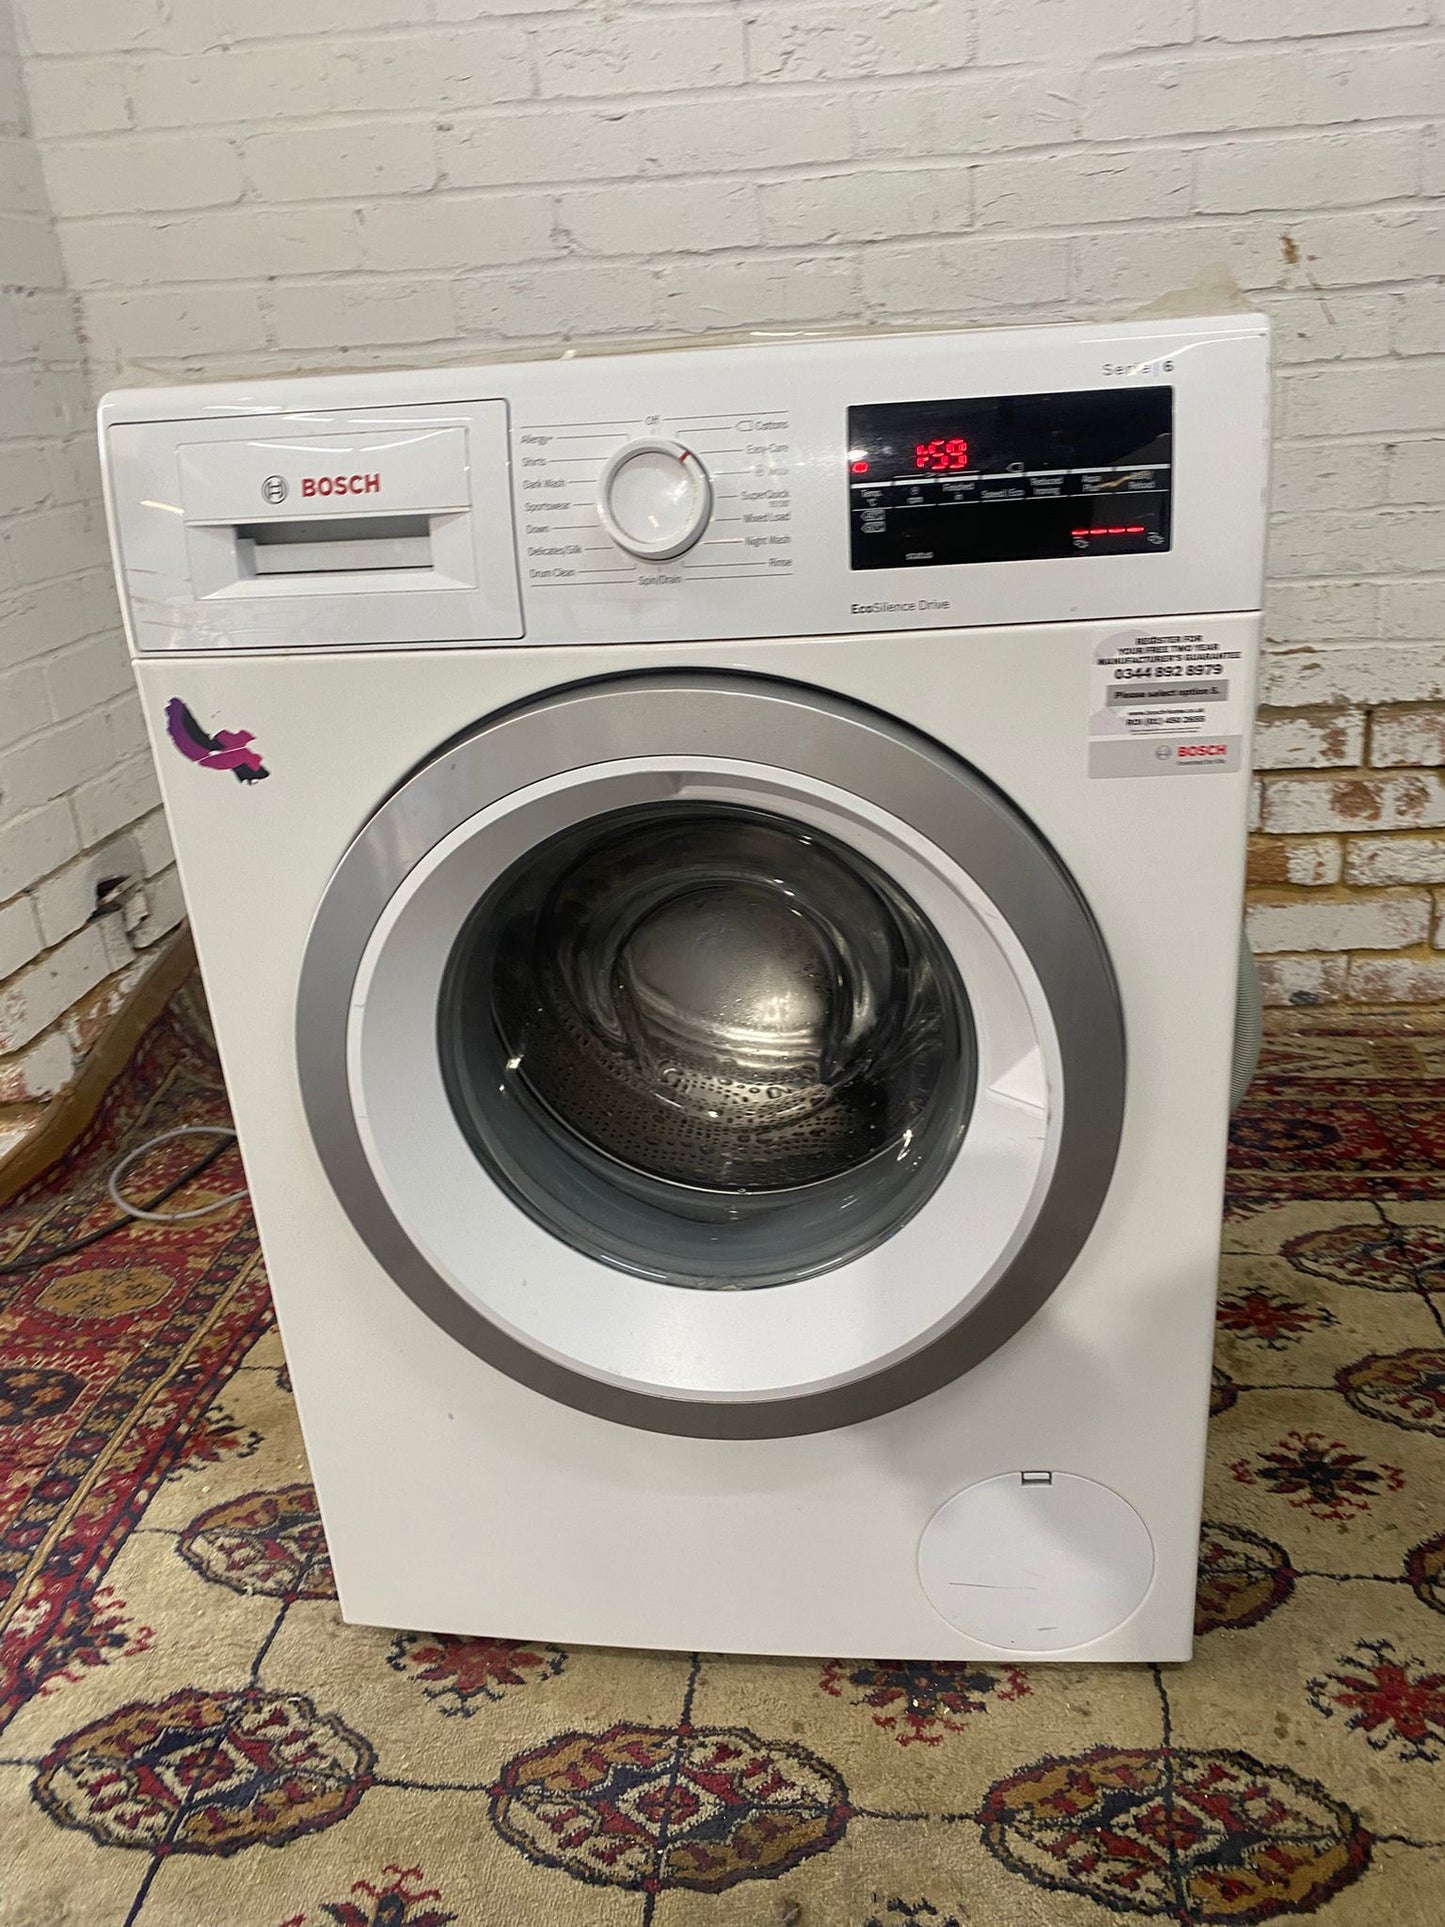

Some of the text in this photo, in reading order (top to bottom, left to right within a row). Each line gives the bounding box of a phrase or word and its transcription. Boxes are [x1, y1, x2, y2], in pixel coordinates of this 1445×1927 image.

[1102, 359, 1175, 376] Sere 6
[302, 473, 380, 497] BOSCH
[851, 599, 951, 614] EcoSilence Drive
[1184, 635, 1203, 643] FOR
[1118, 647, 1143, 655] YOUR
[1146, 646, 1169, 654] FREE
[1194, 643, 1220, 651] YEAR
[1114, 664, 1223, 679] 0344 892 8979
[1114, 690, 1144, 699] Please
[1147, 689, 1176, 698] select
[1177, 745, 1227, 757] BOSCH
